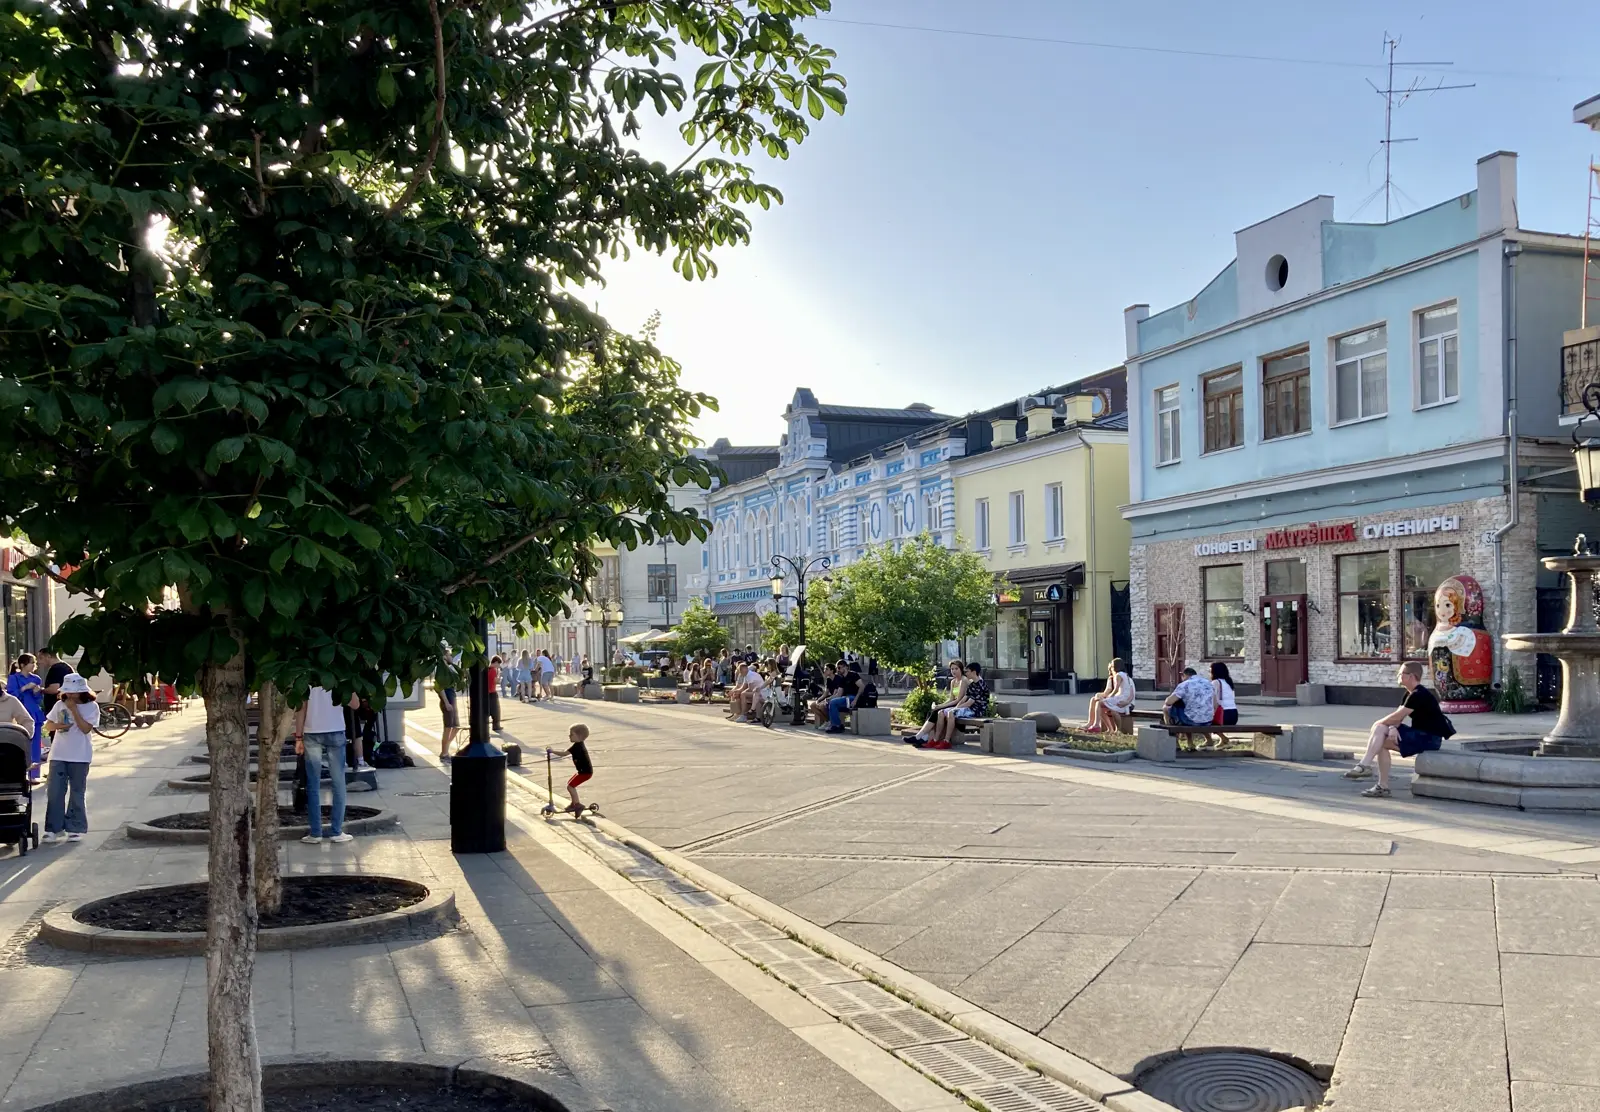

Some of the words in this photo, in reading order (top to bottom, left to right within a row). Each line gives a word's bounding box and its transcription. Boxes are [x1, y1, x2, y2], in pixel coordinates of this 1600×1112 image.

[1194, 538, 1258, 556] КОНФЕТЫ
[1264, 522, 1357, 550] МАТРЁШКА
[1363, 514, 1461, 540] СУВЕНИРЫ
